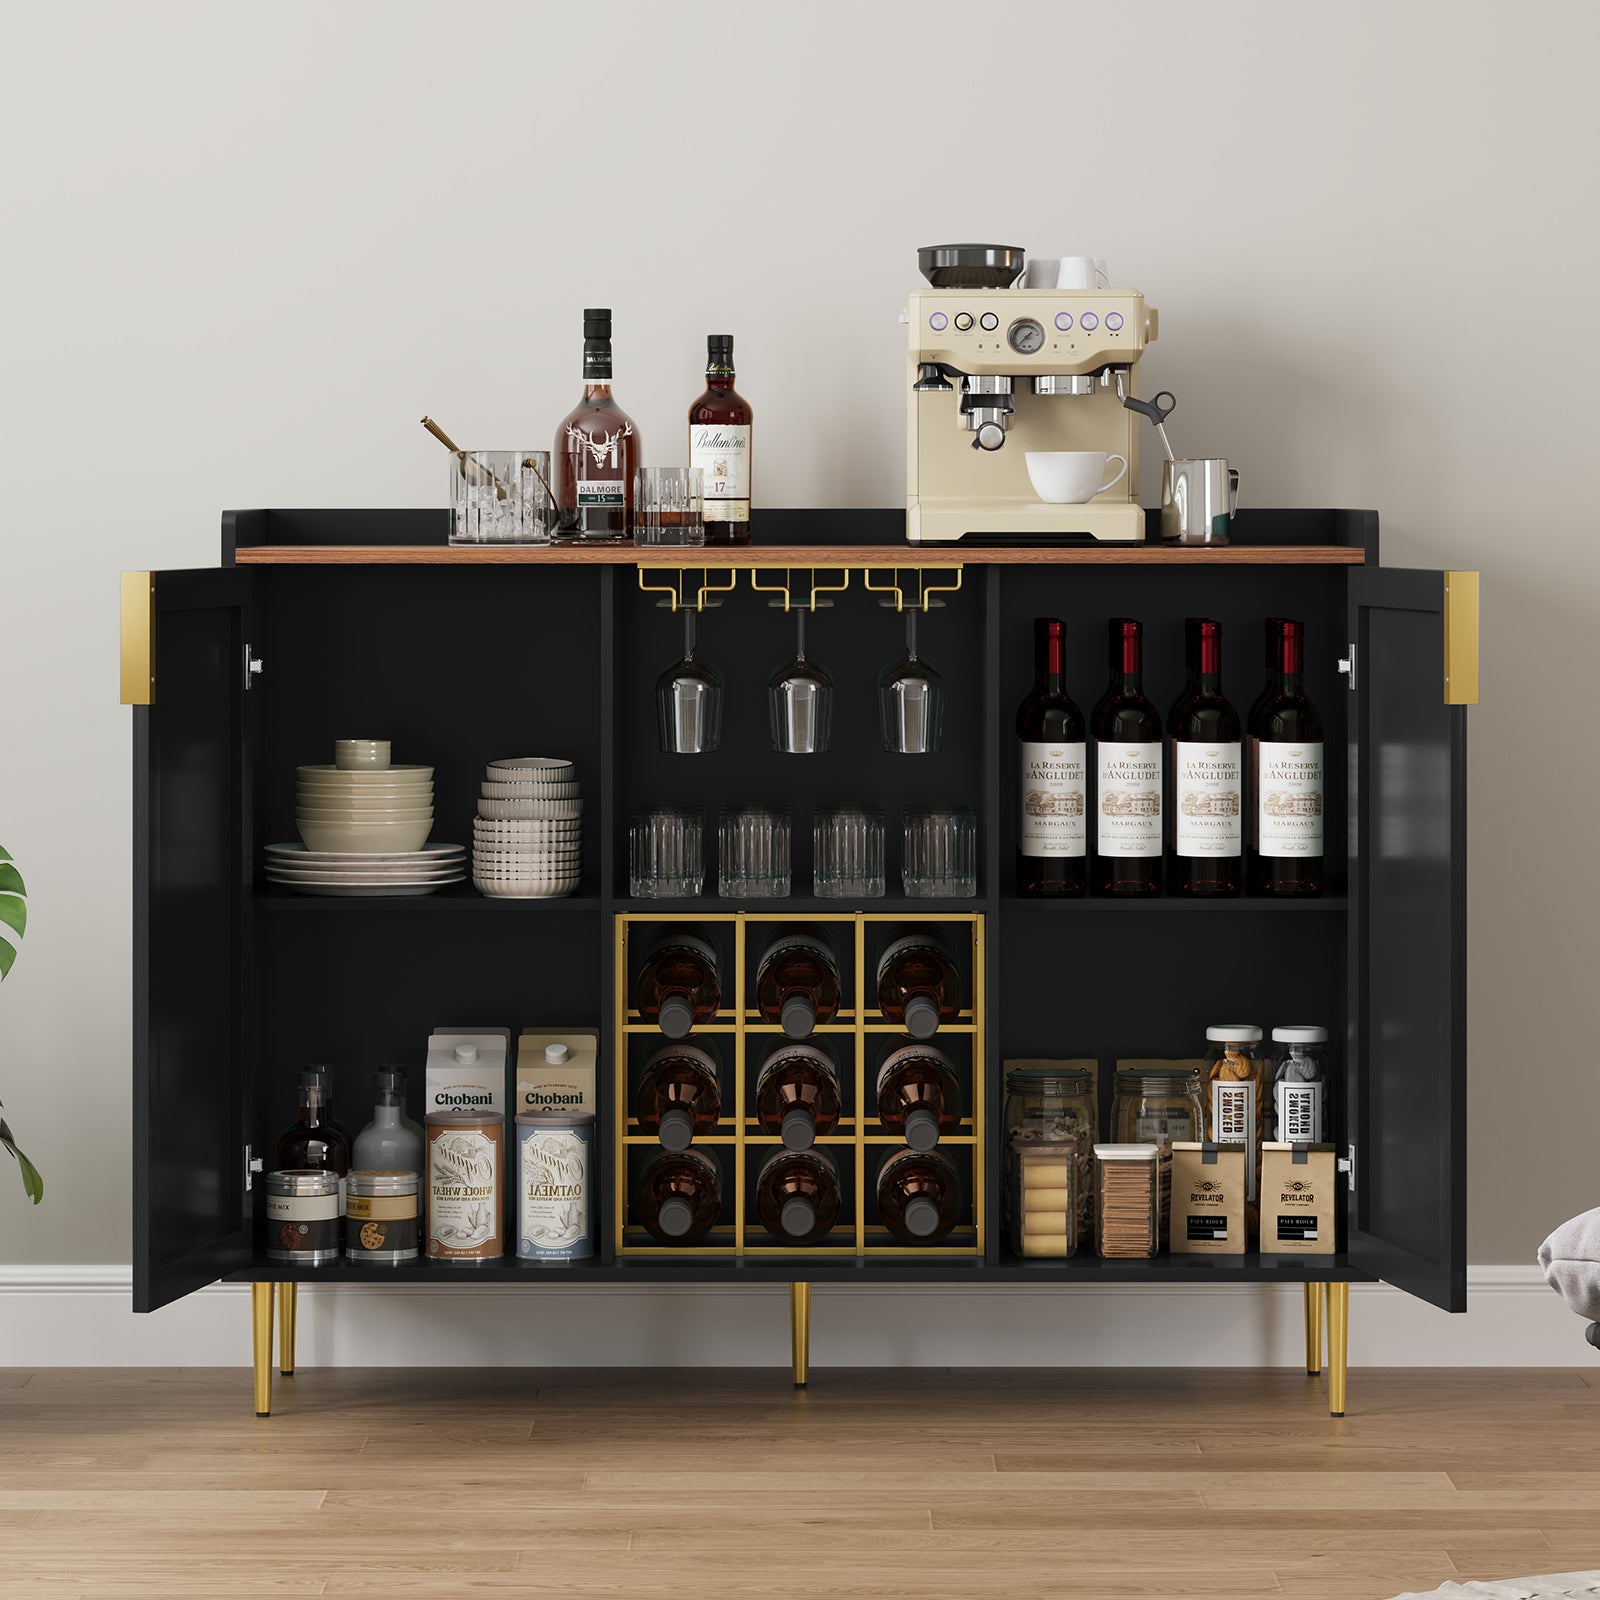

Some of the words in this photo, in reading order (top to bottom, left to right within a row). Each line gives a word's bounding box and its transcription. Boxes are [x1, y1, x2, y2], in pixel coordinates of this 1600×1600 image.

[715, 482, 726, 492] 17
[598, 494, 606, 503] 15
[435, 1092, 492, 1105] Chobani
[526, 1092, 583, 1104] Chobani
[1190, 1193, 1224, 1203] REVELATOR
[1281, 1193, 1314, 1203] REVELATOR
